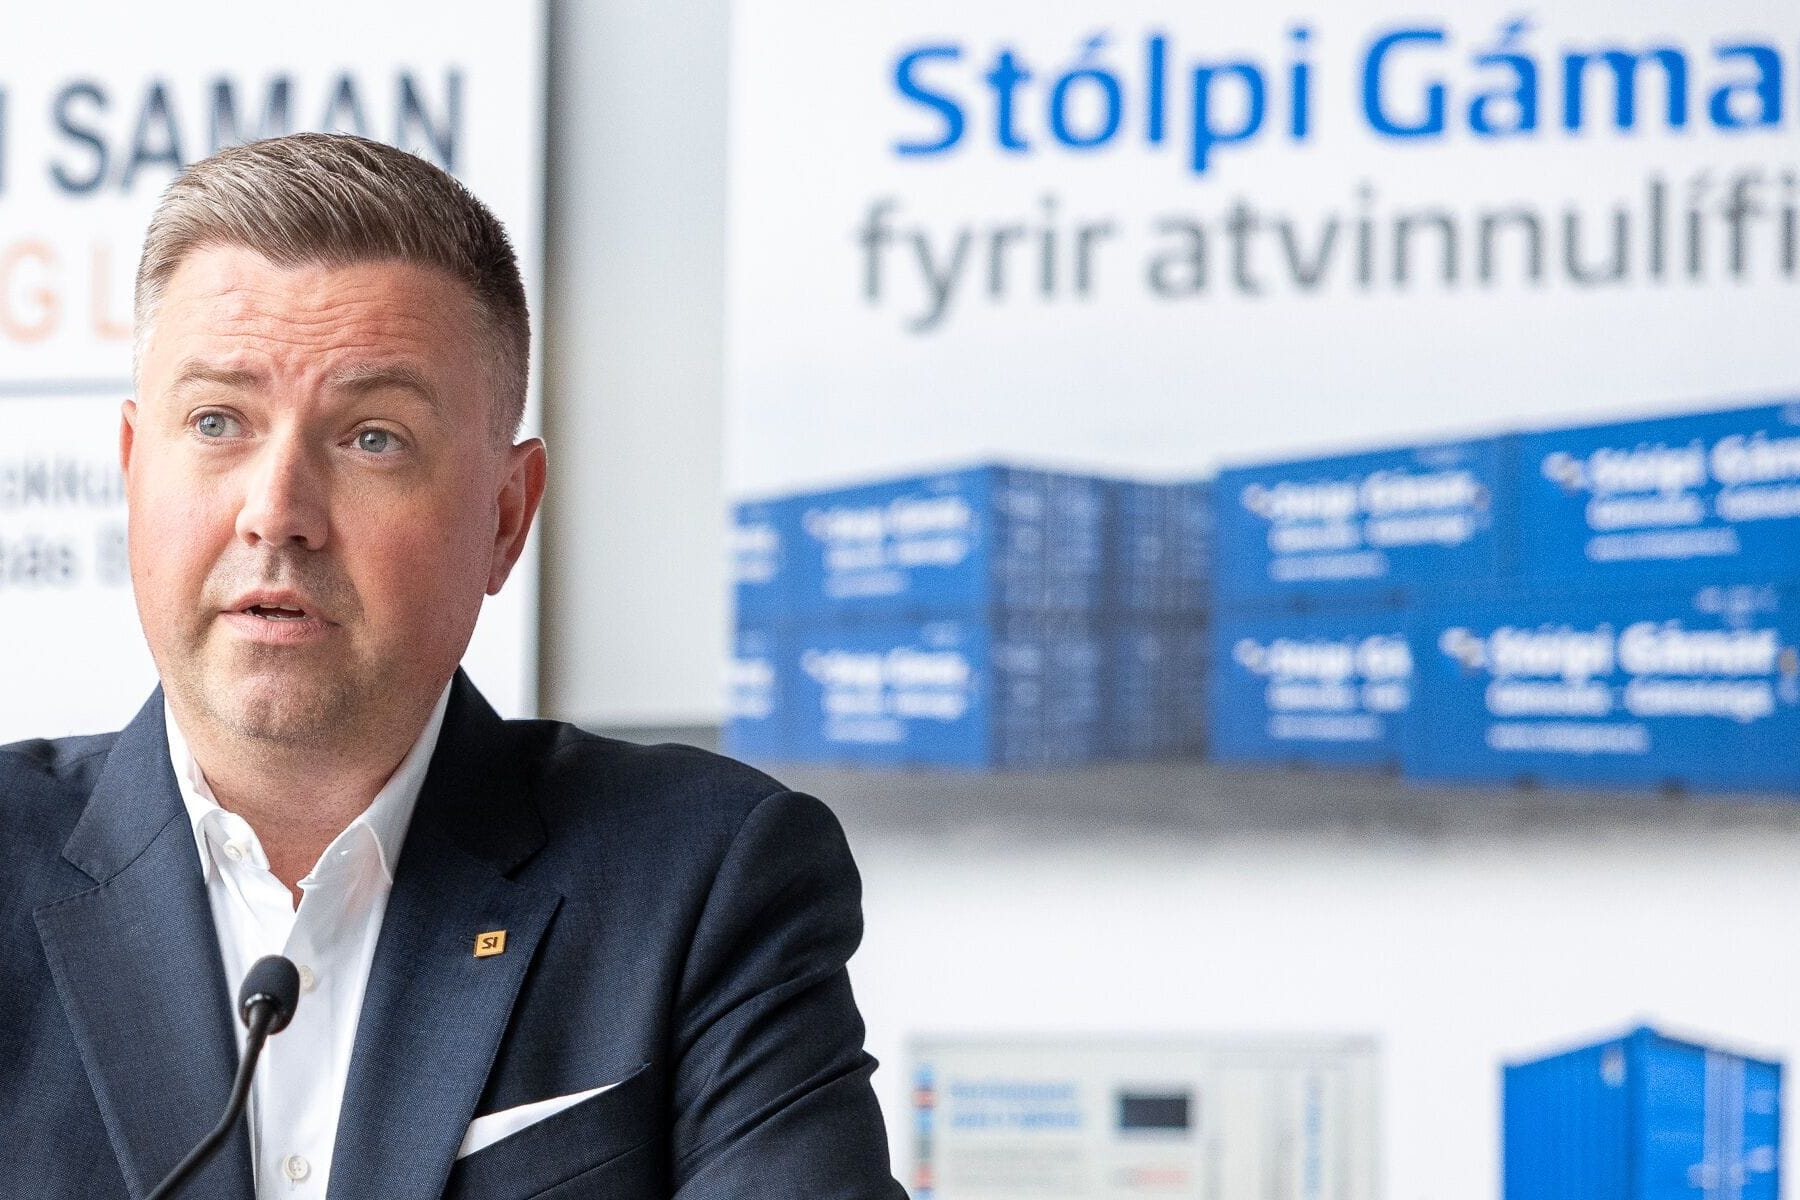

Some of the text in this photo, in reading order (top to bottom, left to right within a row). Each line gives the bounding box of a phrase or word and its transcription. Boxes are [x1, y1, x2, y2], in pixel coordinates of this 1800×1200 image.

[889, 17, 1799, 177] Stólpi Gáma
[856, 198, 1117, 335] fyrir
[481, 936, 498, 950] SI
